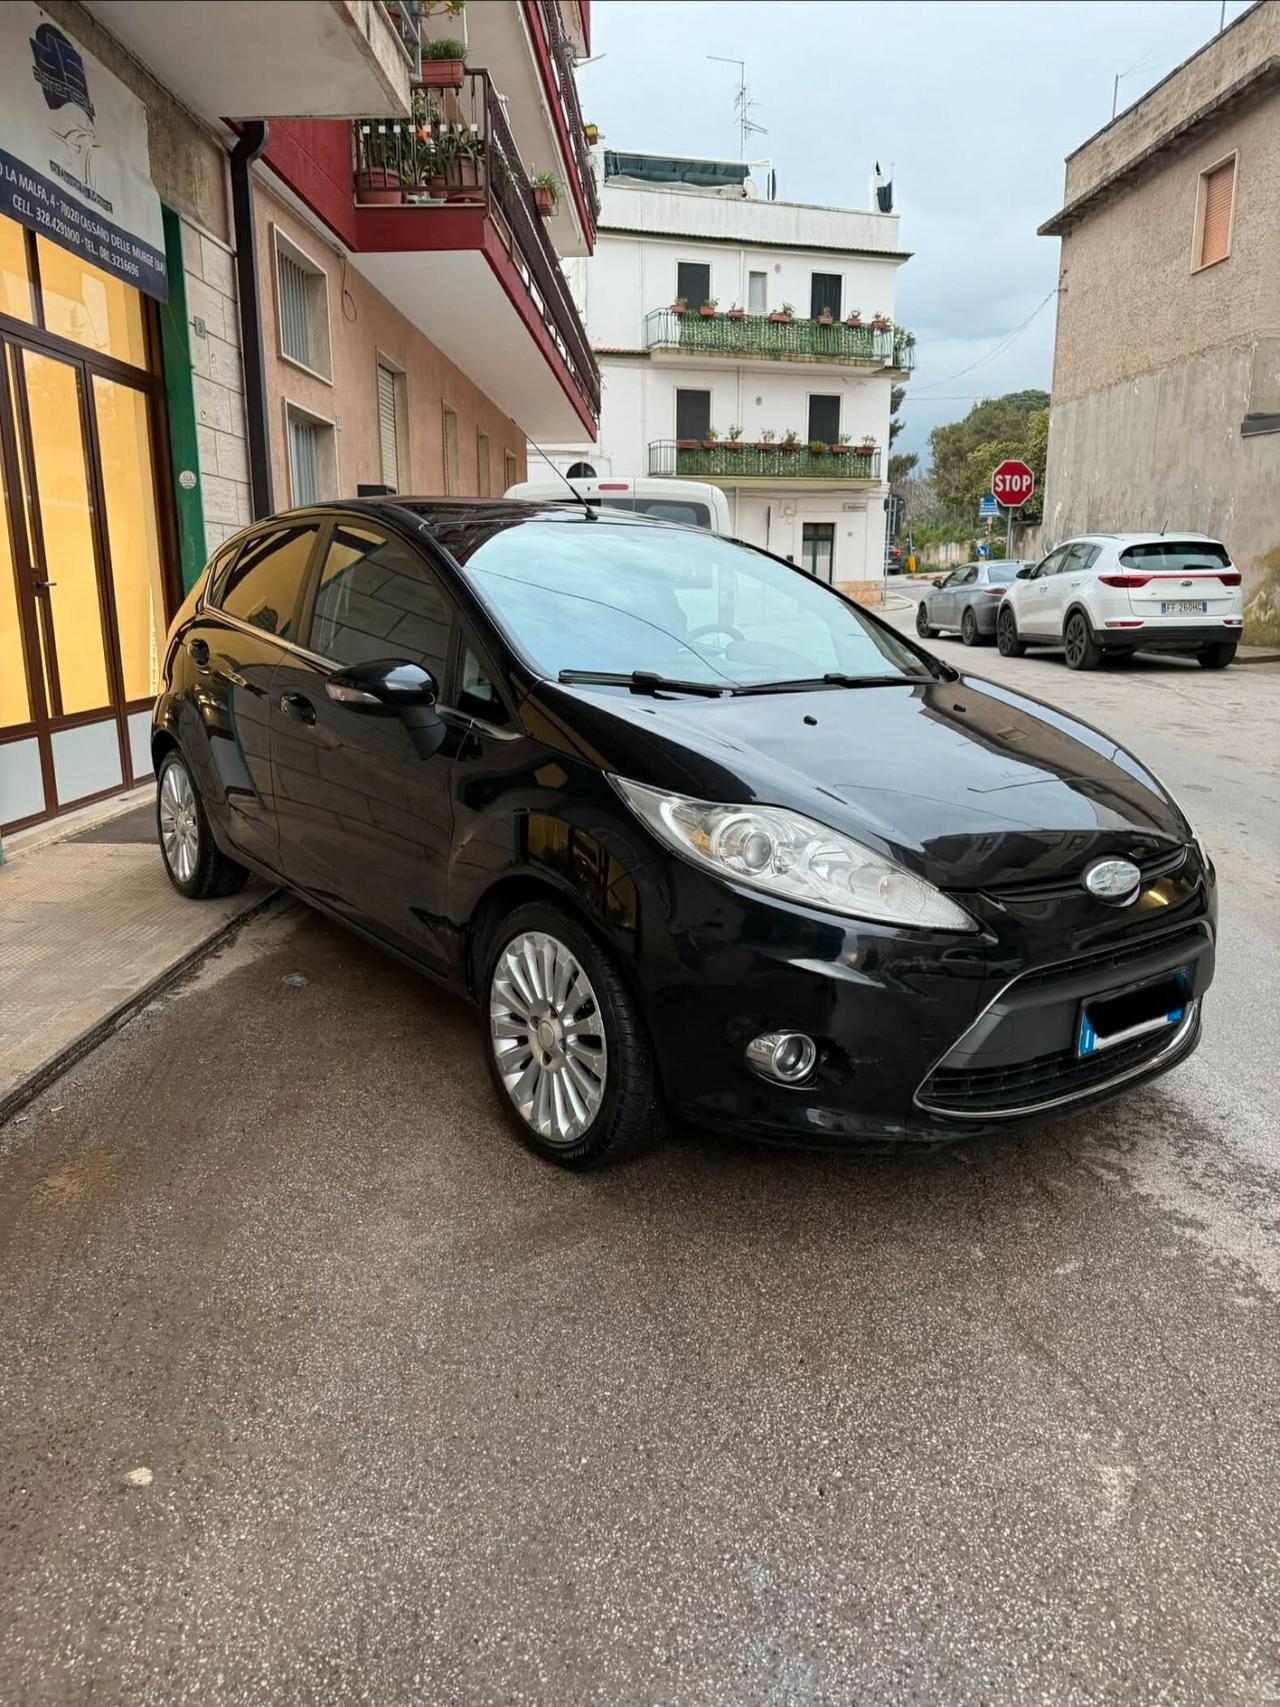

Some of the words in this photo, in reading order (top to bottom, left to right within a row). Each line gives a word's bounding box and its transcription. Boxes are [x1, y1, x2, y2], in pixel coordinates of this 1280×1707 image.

[6, 165, 17, 185] LA
[19, 173, 49, 206] MALFA,
[50, 194, 56, 207] 4
[80, 214, 110, 243] CASSANO
[110, 233, 131, 255] DELLE
[132, 244, 154, 268] MURGE
[12, 194, 34, 218] CELL.
[84, 237, 98, 256] TEL.
[995, 475, 1031, 492] STOP
